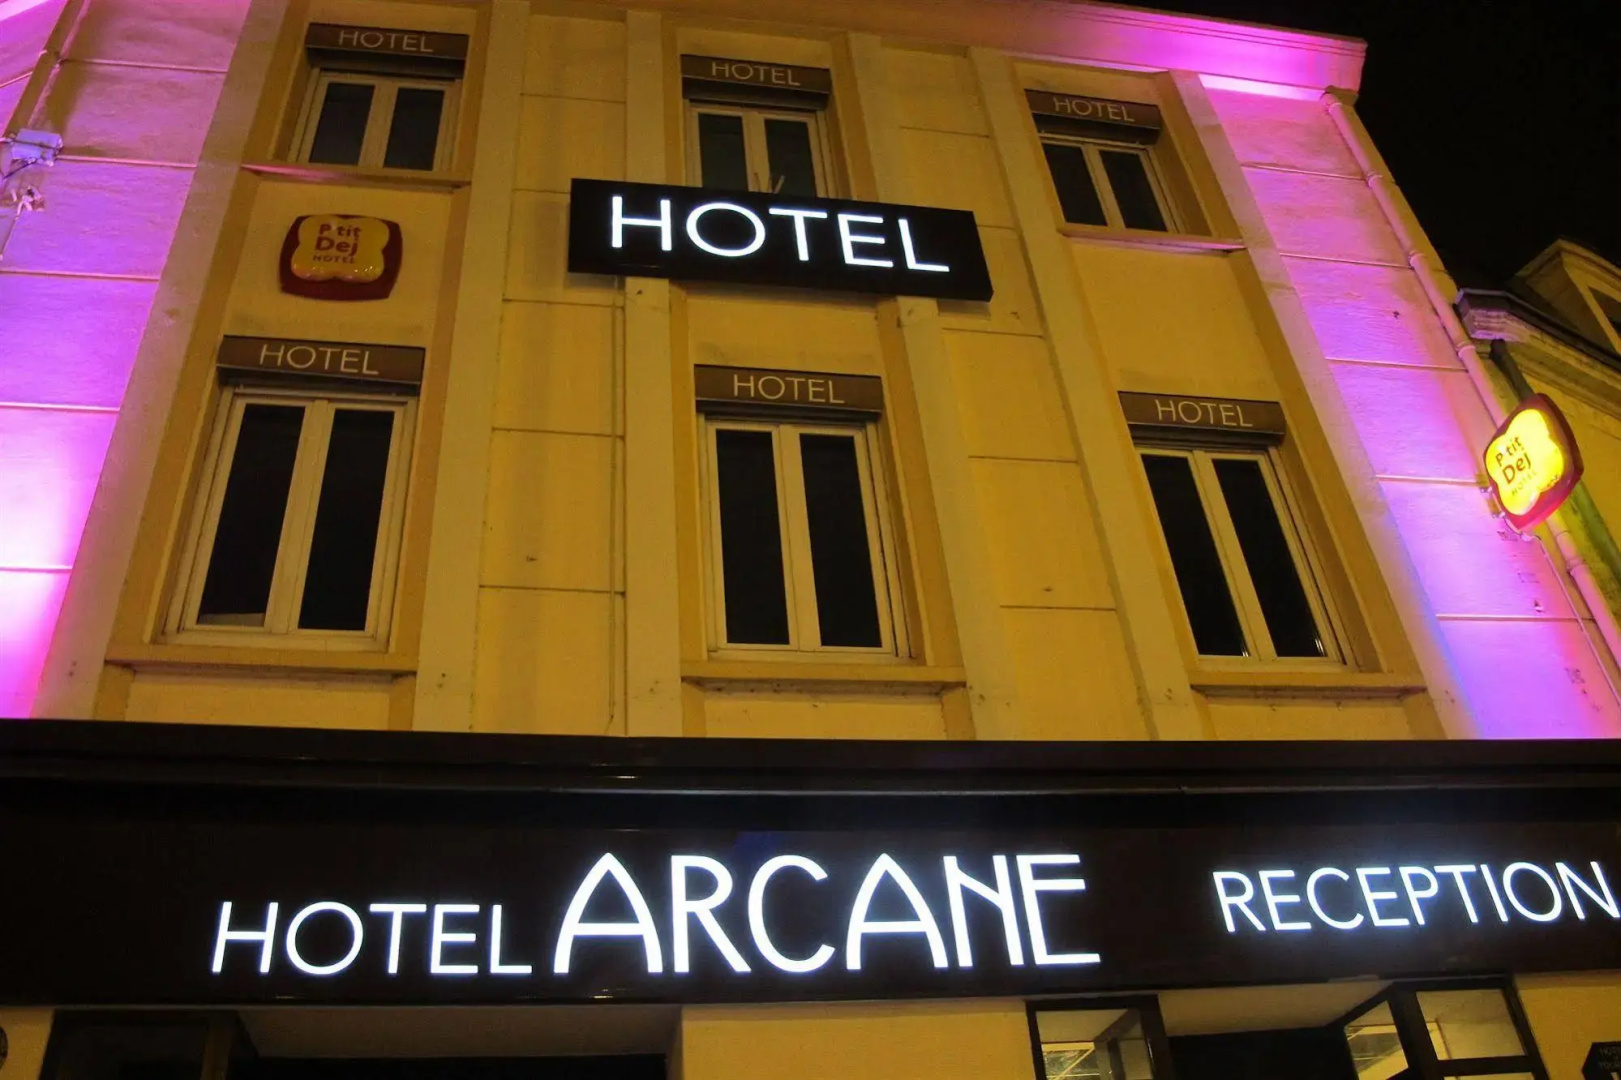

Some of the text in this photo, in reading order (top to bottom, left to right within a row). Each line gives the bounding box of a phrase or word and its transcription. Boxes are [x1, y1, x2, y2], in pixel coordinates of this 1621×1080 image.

[338, 30, 434, 53] HOTEL
[711, 60, 801, 87] HOTEL
[1053, 96, 1136, 123] HOTEL
[610, 195, 951, 273] HOTEL
[312, 254, 356, 265] HOTEL
[258, 344, 380, 375] HOTEL
[732, 373, 846, 404] HOTEL
[1154, 399, 1254, 428] HOTEL
[1212, 860, 1621, 933] RECEPTION
[211, 852, 1101, 976] HOTEL ARCANE
